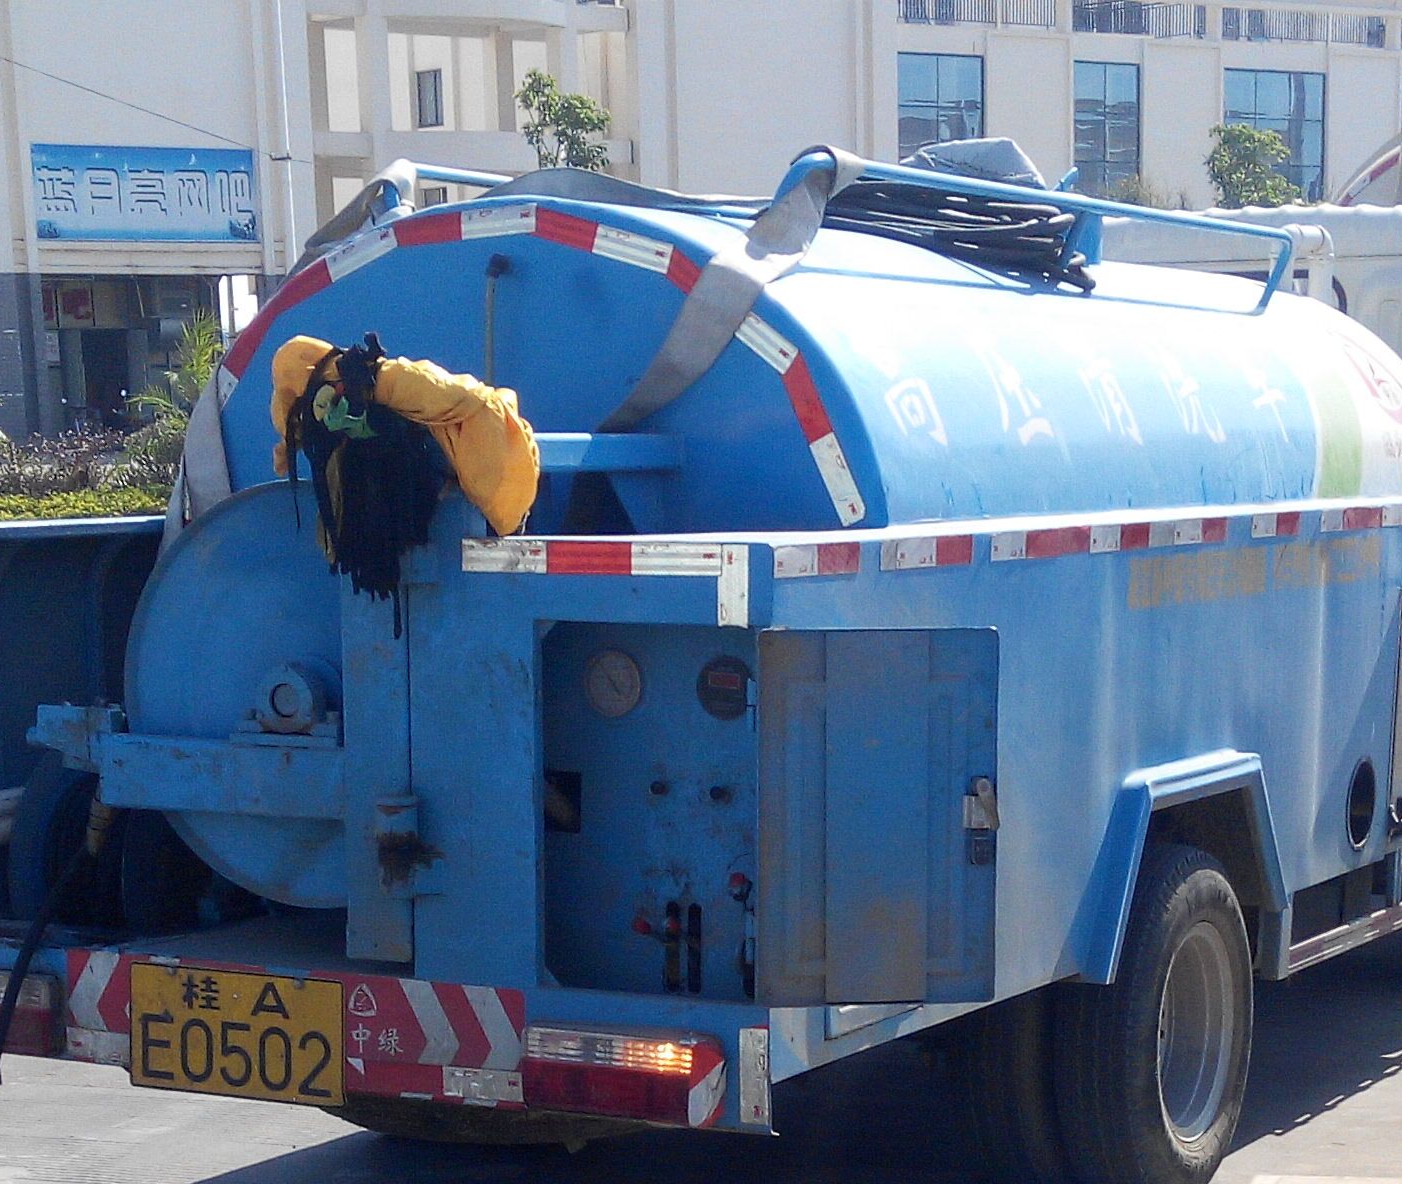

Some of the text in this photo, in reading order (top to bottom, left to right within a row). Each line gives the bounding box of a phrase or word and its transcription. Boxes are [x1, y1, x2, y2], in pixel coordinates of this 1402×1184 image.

[35, 165, 254, 216] 蓝月亮网吧
[181, 974, 290, 1020] 桂 A
[140, 1009, 333, 1098] E0502
[351, 1022, 404, 1057] 中绿
